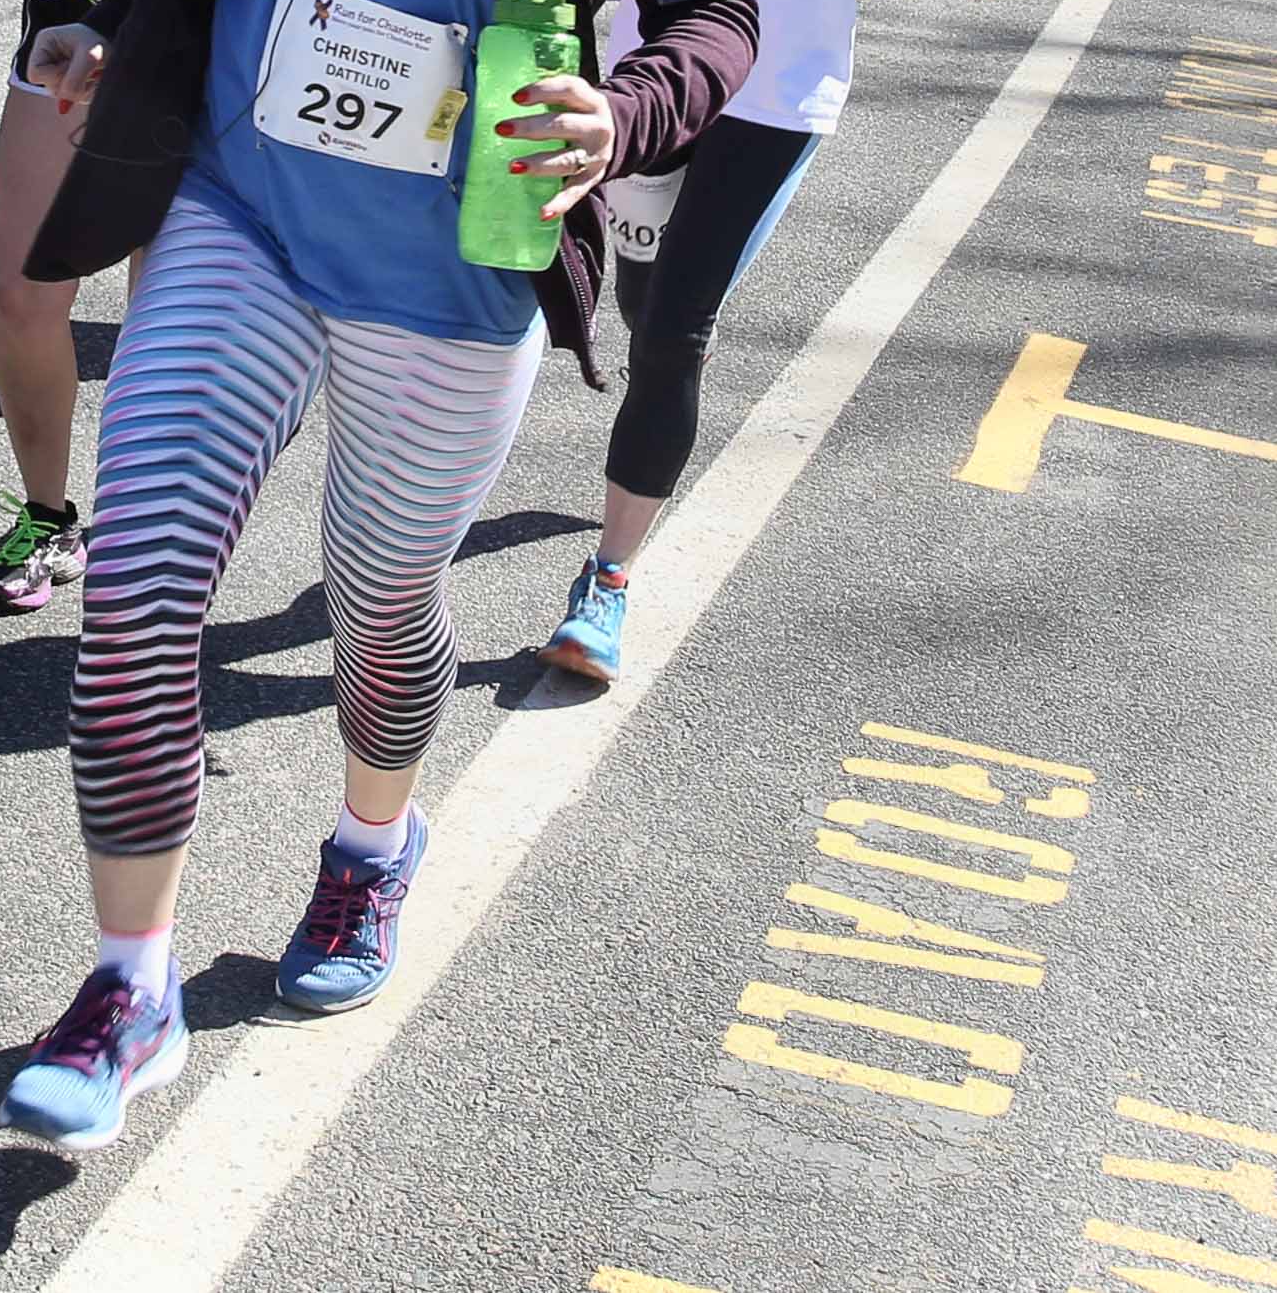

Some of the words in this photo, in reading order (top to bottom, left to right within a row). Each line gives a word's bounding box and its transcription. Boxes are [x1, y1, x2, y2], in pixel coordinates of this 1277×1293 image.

[333, 3, 356, 19] Run
[357, 11, 376, 24] for
[377, 17, 432, 44] Charlotte
[313, 37, 412, 79] CHRISTINE
[325, 63, 391, 91] DATTILIO
[297, 83, 404, 140] 297
[722, 720, 1098, 1118] ROAD
